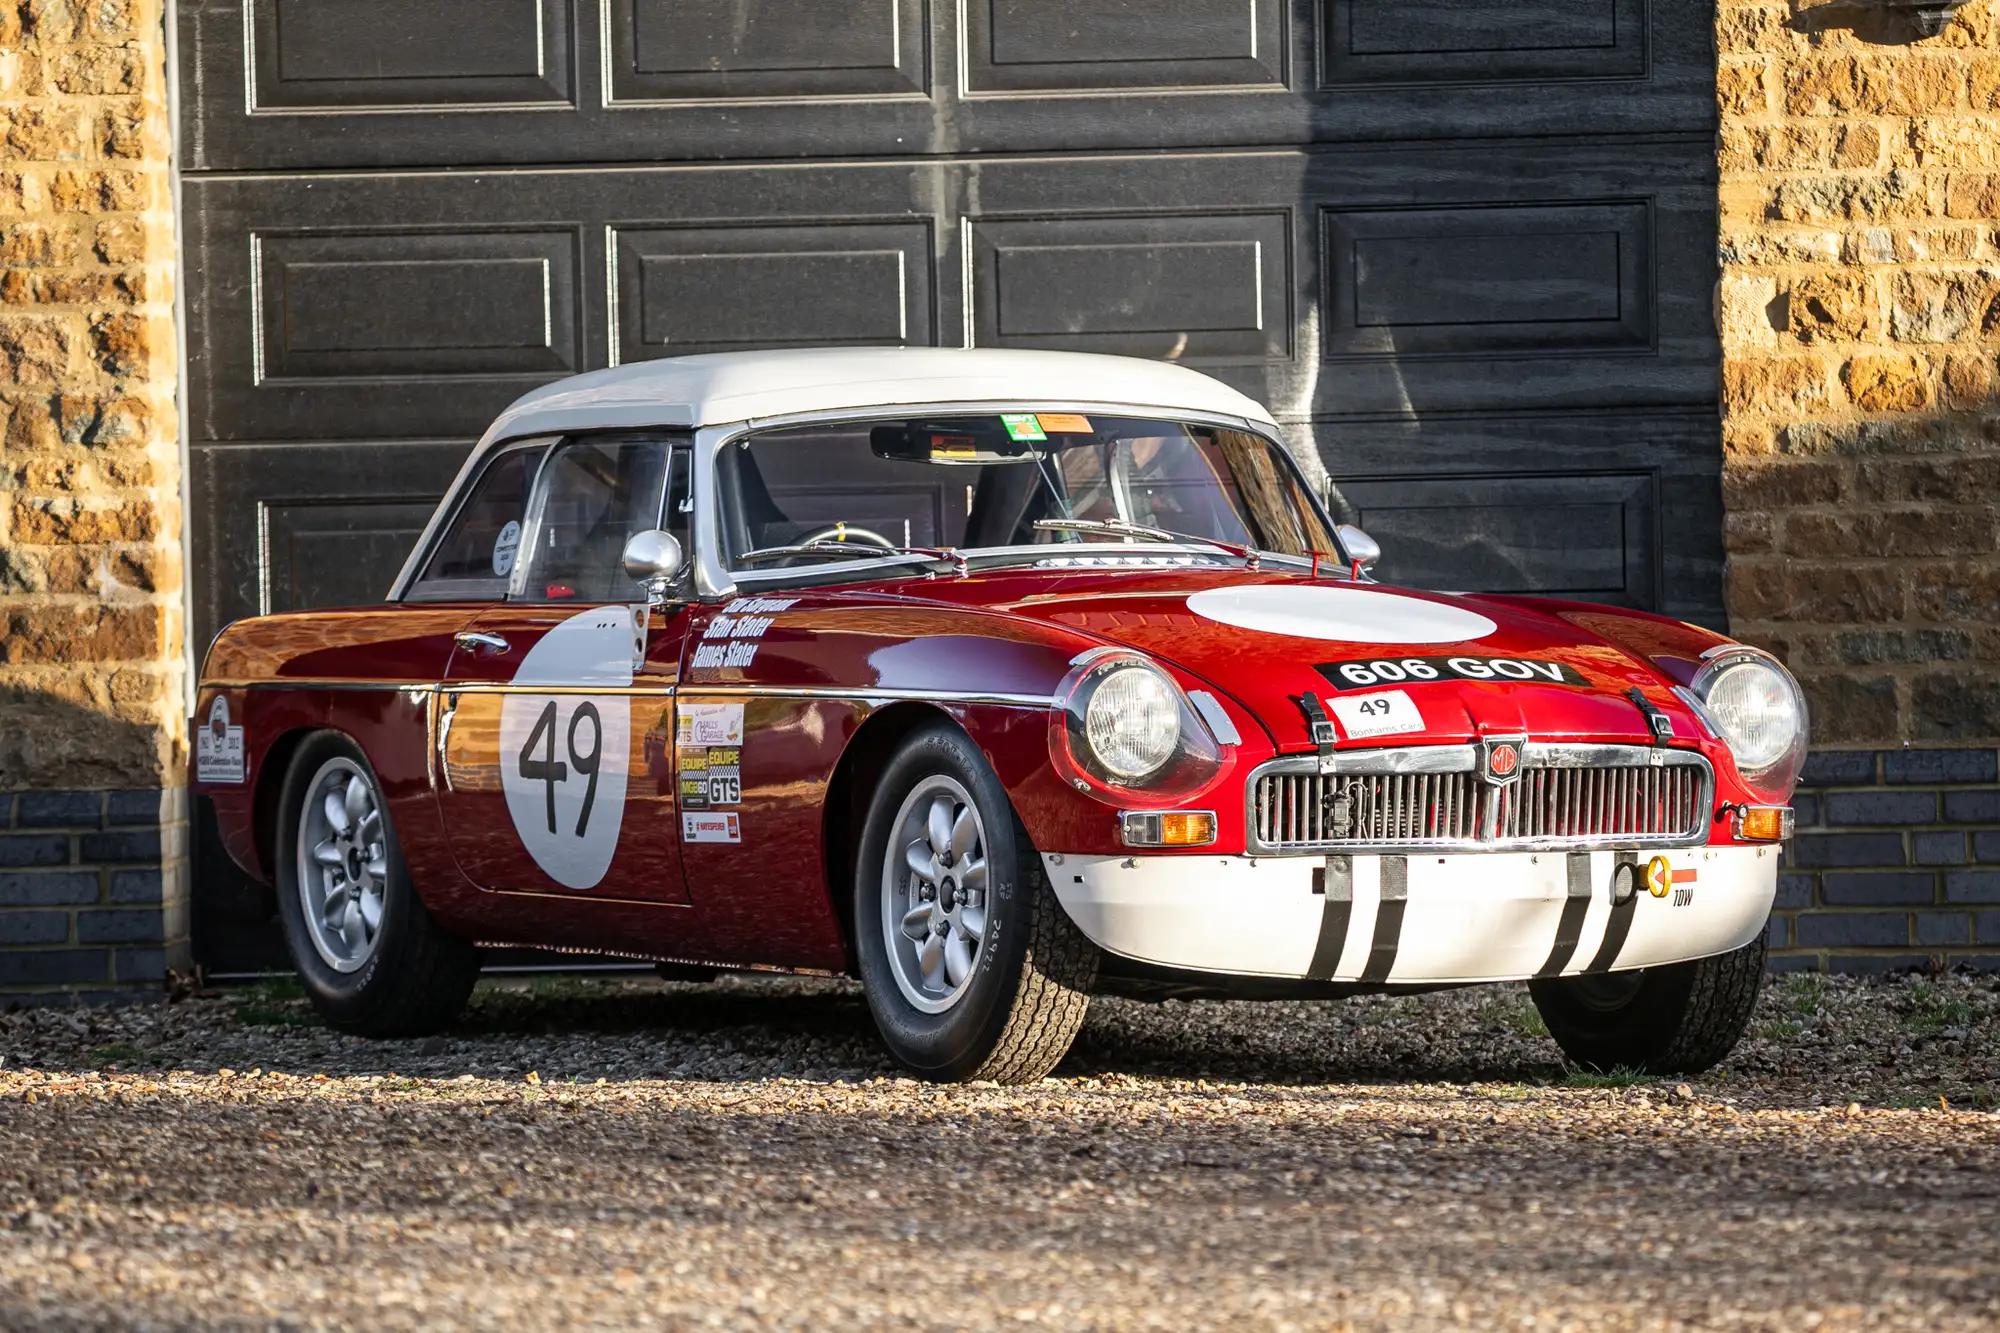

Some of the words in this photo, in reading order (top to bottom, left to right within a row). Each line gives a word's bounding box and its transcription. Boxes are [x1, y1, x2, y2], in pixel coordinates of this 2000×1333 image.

[703, 615, 738, 639] Stan
[730, 614, 775, 638] Slater
[691, 641, 728, 668] James
[723, 640, 759, 668] Slater
[1339, 657, 1439, 686] 606
[1446, 656, 1565, 684] GOV
[1358, 697, 1392, 718] 49
[1350, 724, 1398, 738] Bonhams
[1400, 719, 1424, 733] Cars
[519, 700, 602, 838] 49
[682, 758, 707, 770] EQUIPE
[709, 750, 739, 765] EQUIPE
[1492, 747, 1516, 772] MG
[709, 777, 739, 802] GTS
[1673, 889, 1694, 907] TOW
